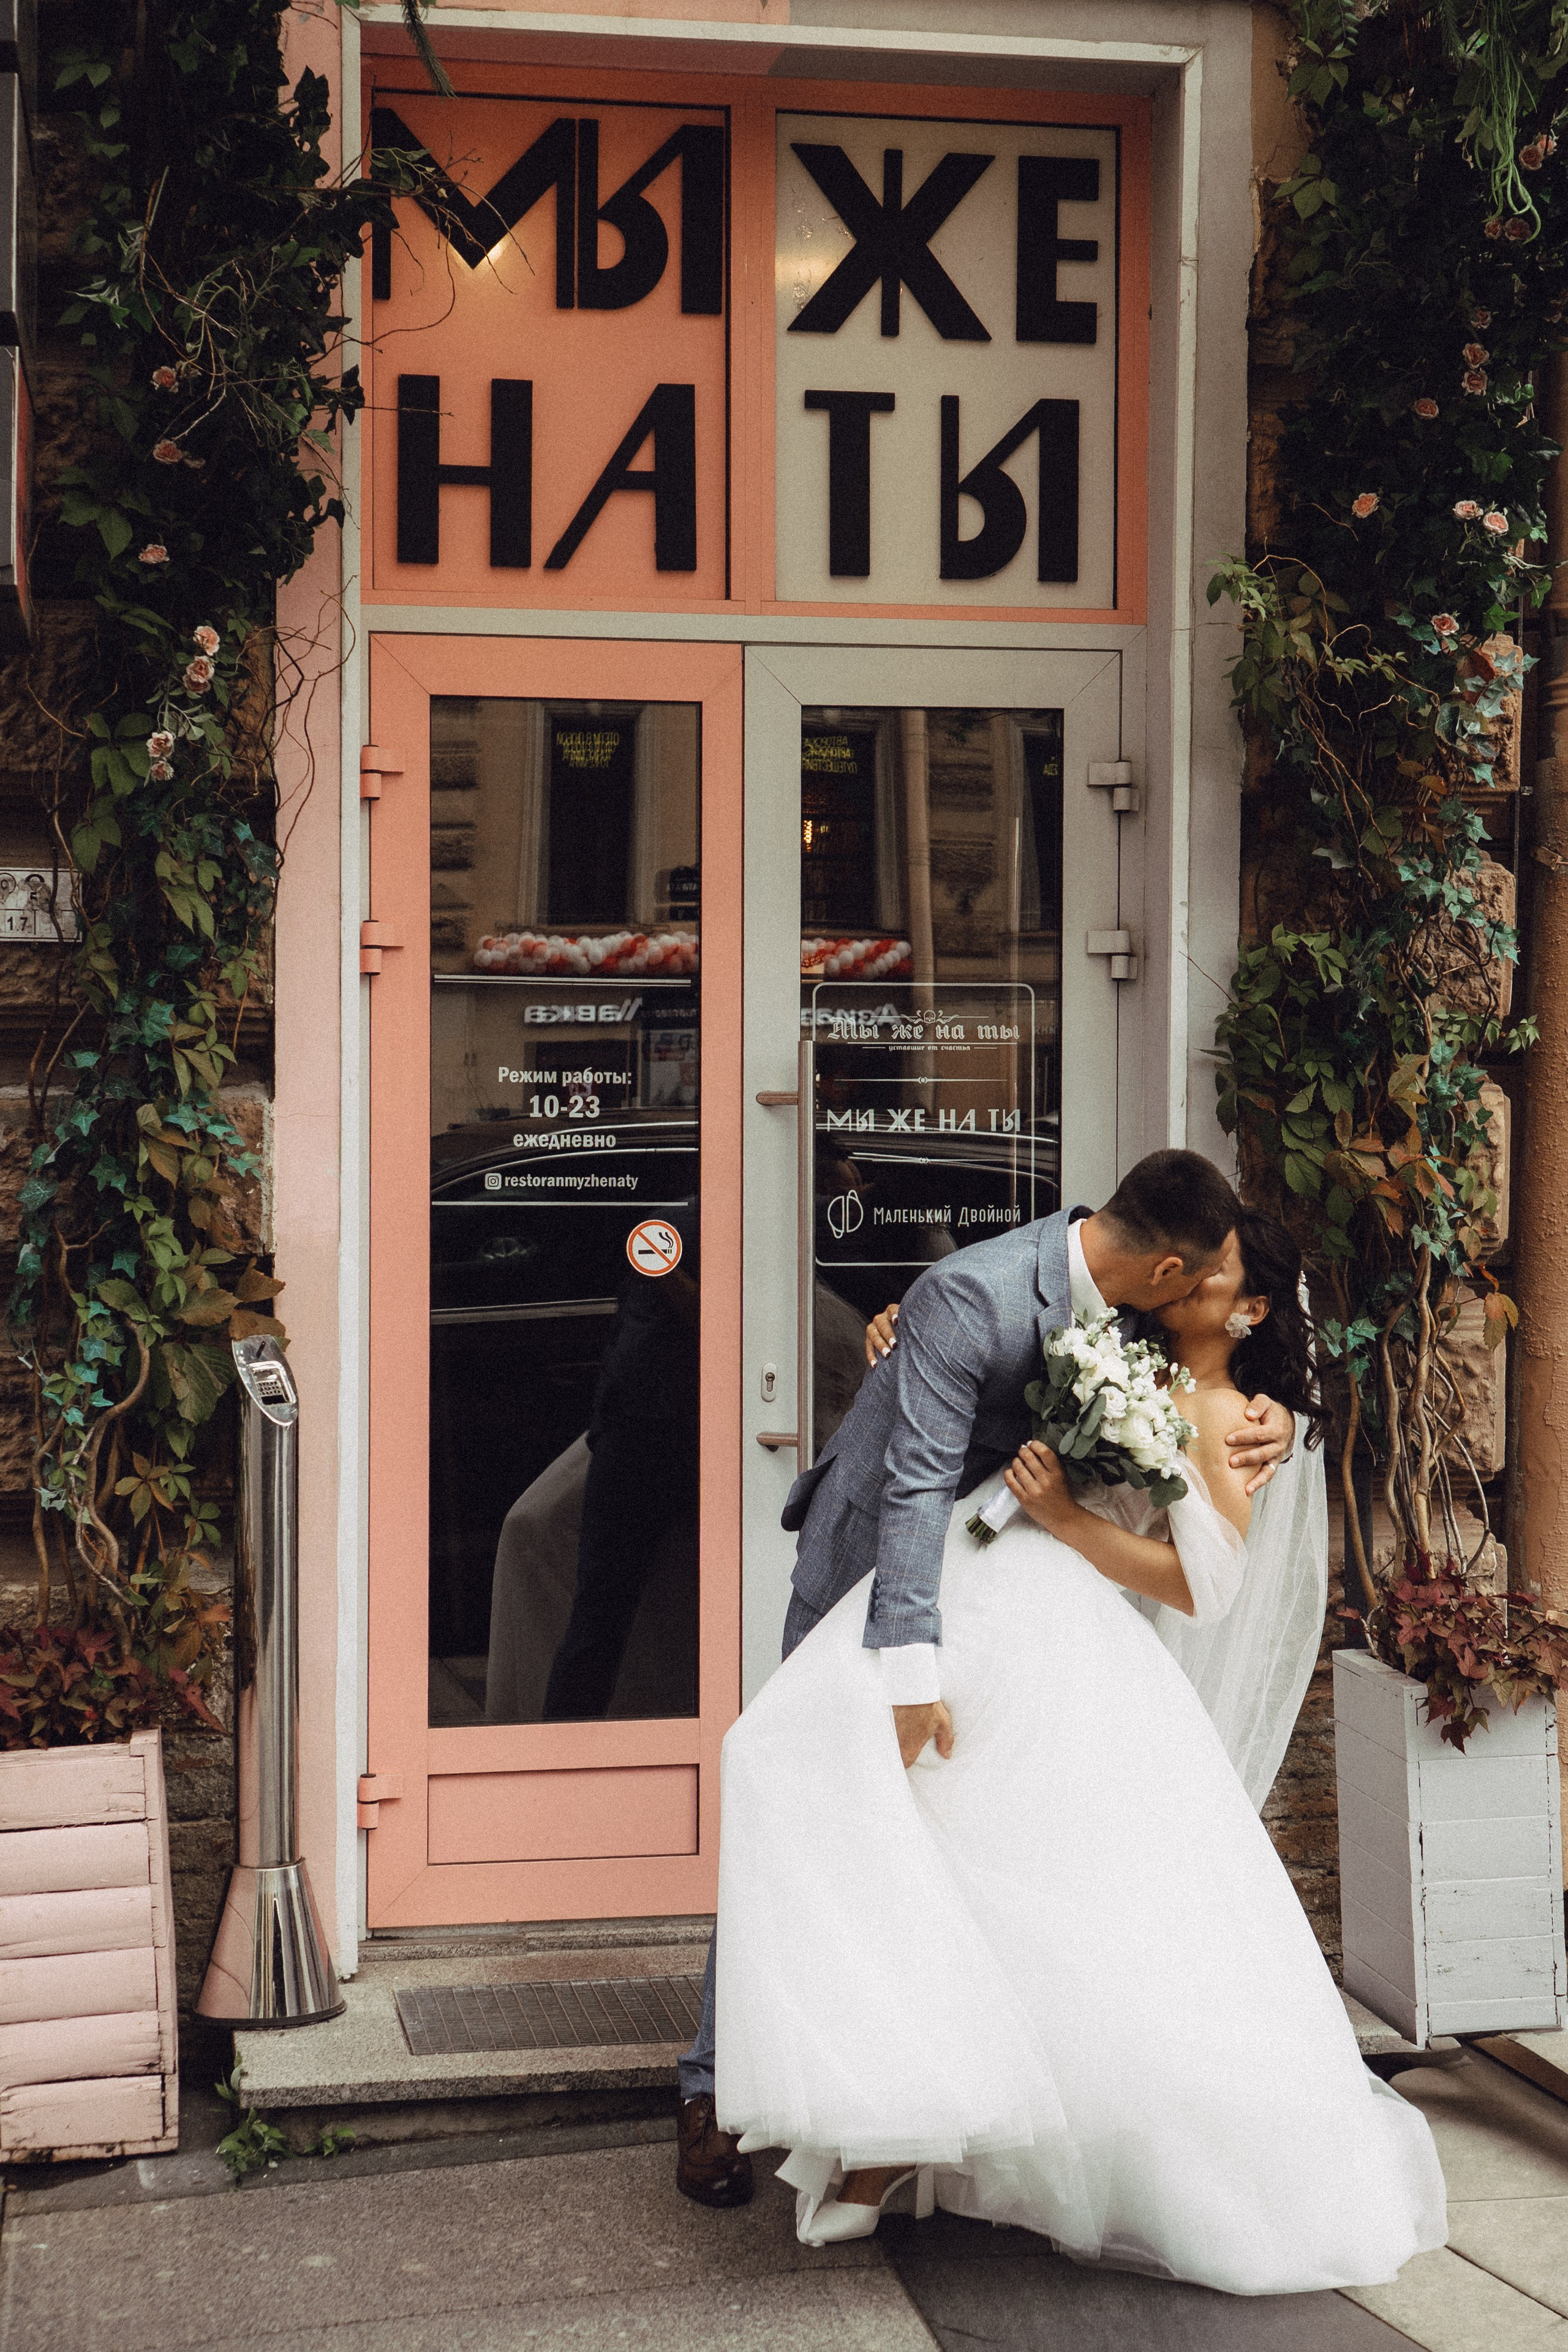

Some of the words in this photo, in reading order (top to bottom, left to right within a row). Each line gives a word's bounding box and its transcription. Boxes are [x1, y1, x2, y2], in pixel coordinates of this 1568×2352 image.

[788, 143, 1099, 344] ЖЕ
[397, 374, 696, 571] НА
[804, 390, 1079, 582] ТЫ
[827, 1017, 880, 1040] Мы
[891, 1024, 923, 1040] же
[935, 1024, 965, 1040] на
[978, 1025, 1020, 1040] ты
[498, 1066, 557, 1084] Режим
[562, 1067, 631, 1087] работы:
[530, 1095, 600, 1118] 10-23
[888, 1109, 925, 1132] ЖЕ
[940, 1109, 975, 1132] НА
[513, 1134, 616, 1150] ежедневно
[505, 1174, 638, 1190] restoranmyzhenaty
